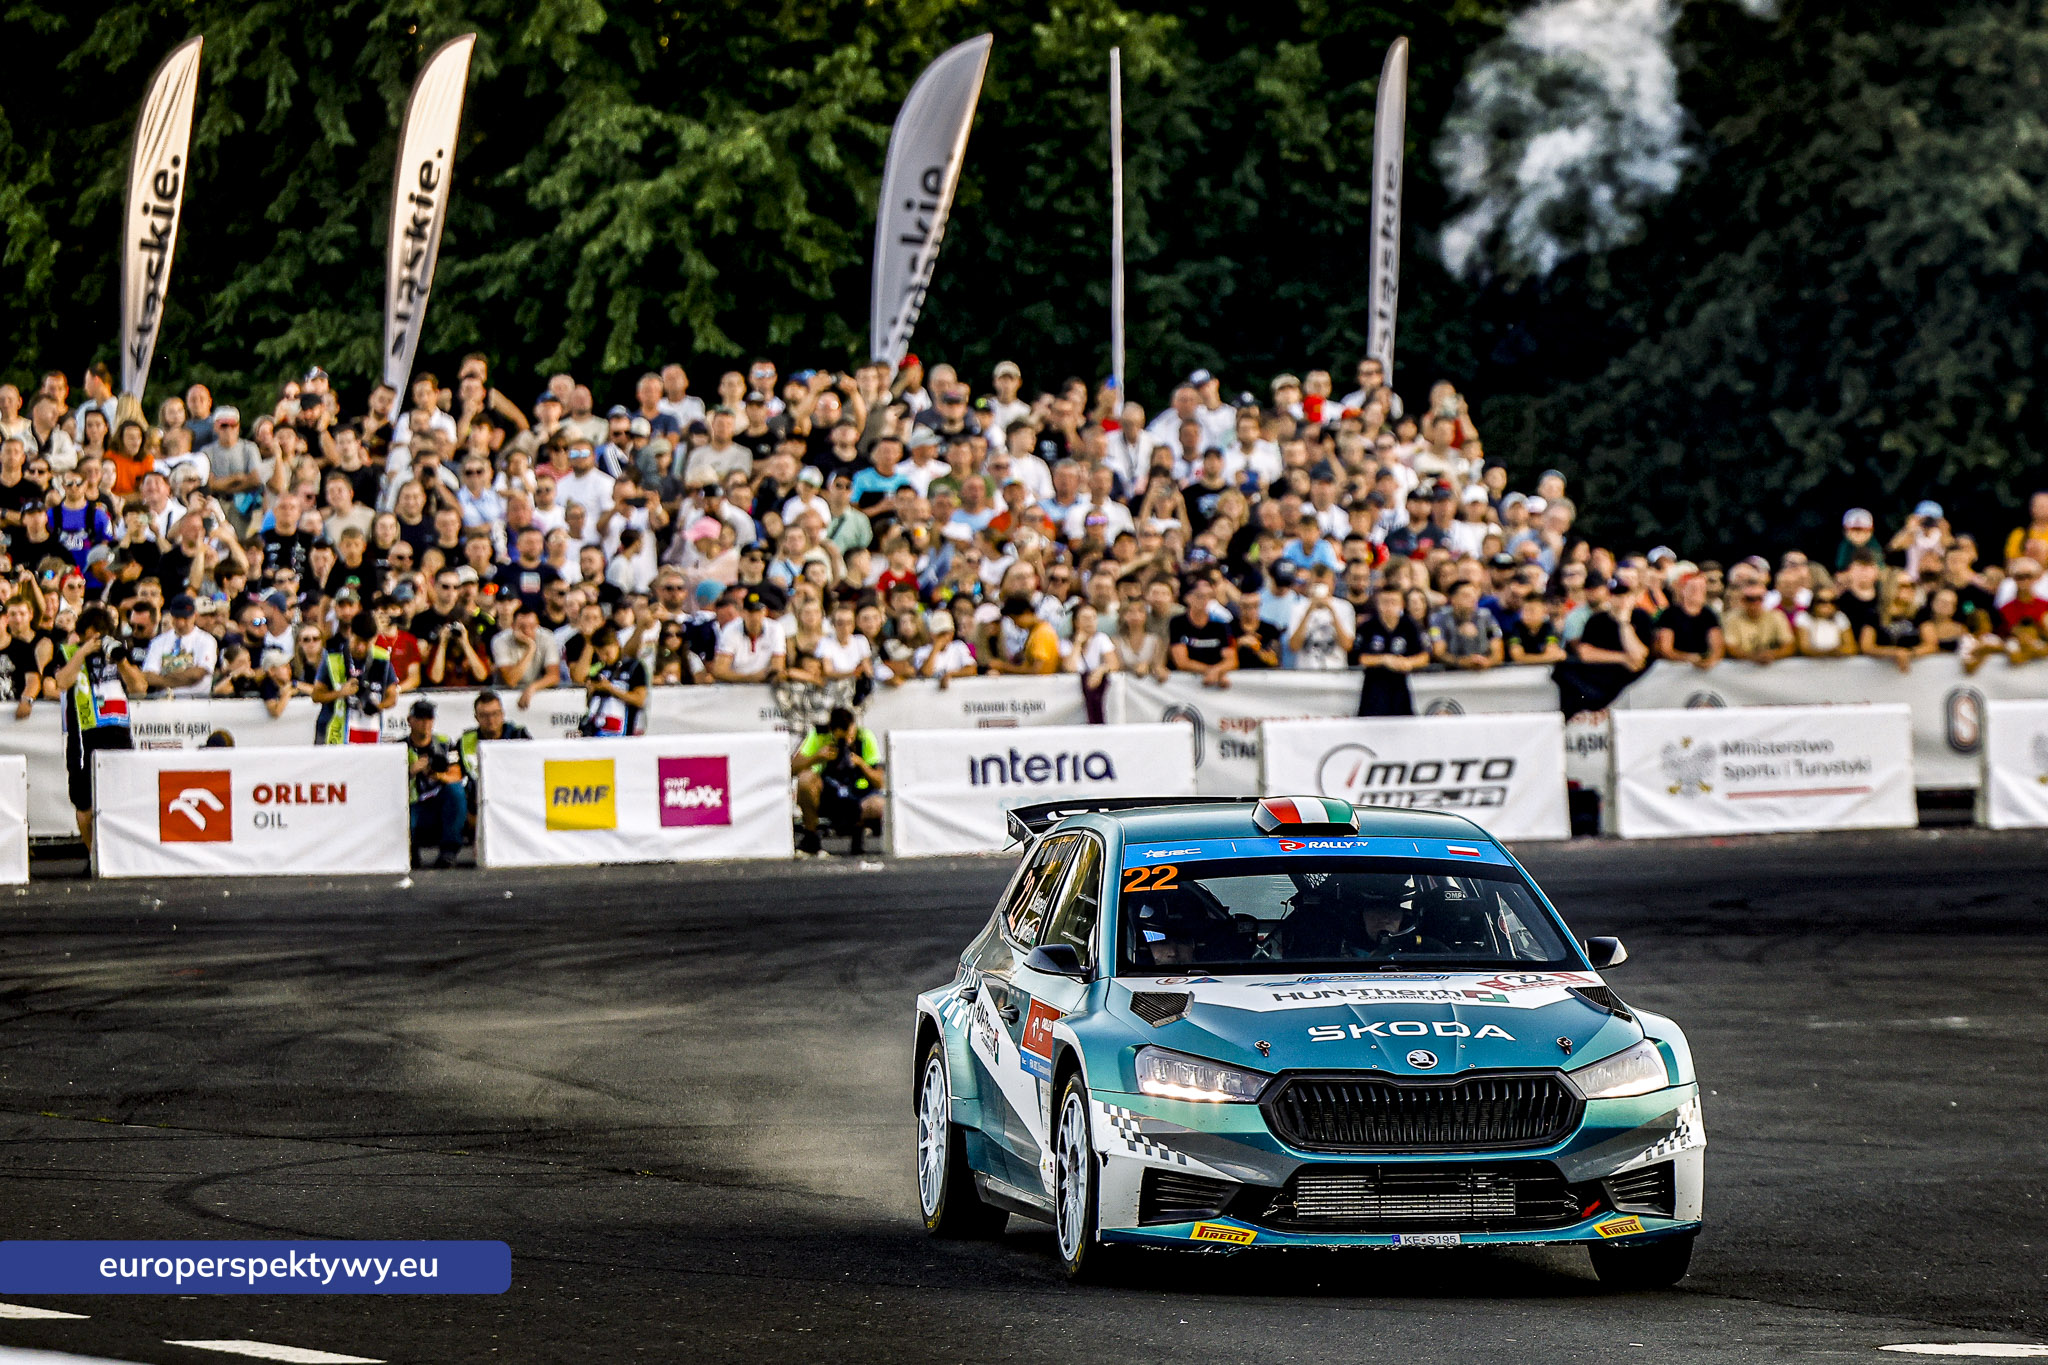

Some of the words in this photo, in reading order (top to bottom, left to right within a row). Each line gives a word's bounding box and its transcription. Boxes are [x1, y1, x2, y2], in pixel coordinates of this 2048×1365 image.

[133, 723, 171, 735] TADION
[970, 747, 1117, 785] interia
[1365, 758, 1516, 786] MOTO
[253, 782, 347, 805] ORLEN
[553, 785, 609, 807] RMF
[254, 811, 287, 830] OIL
[1123, 865, 1178, 893] 22
[1503, 974, 1555, 983] 22
[1272, 987, 1462, 1002] HUN-Therm
[1197, 1225, 1250, 1242] PIRELLI
[1600, 1219, 1640, 1235] PIRELLI
